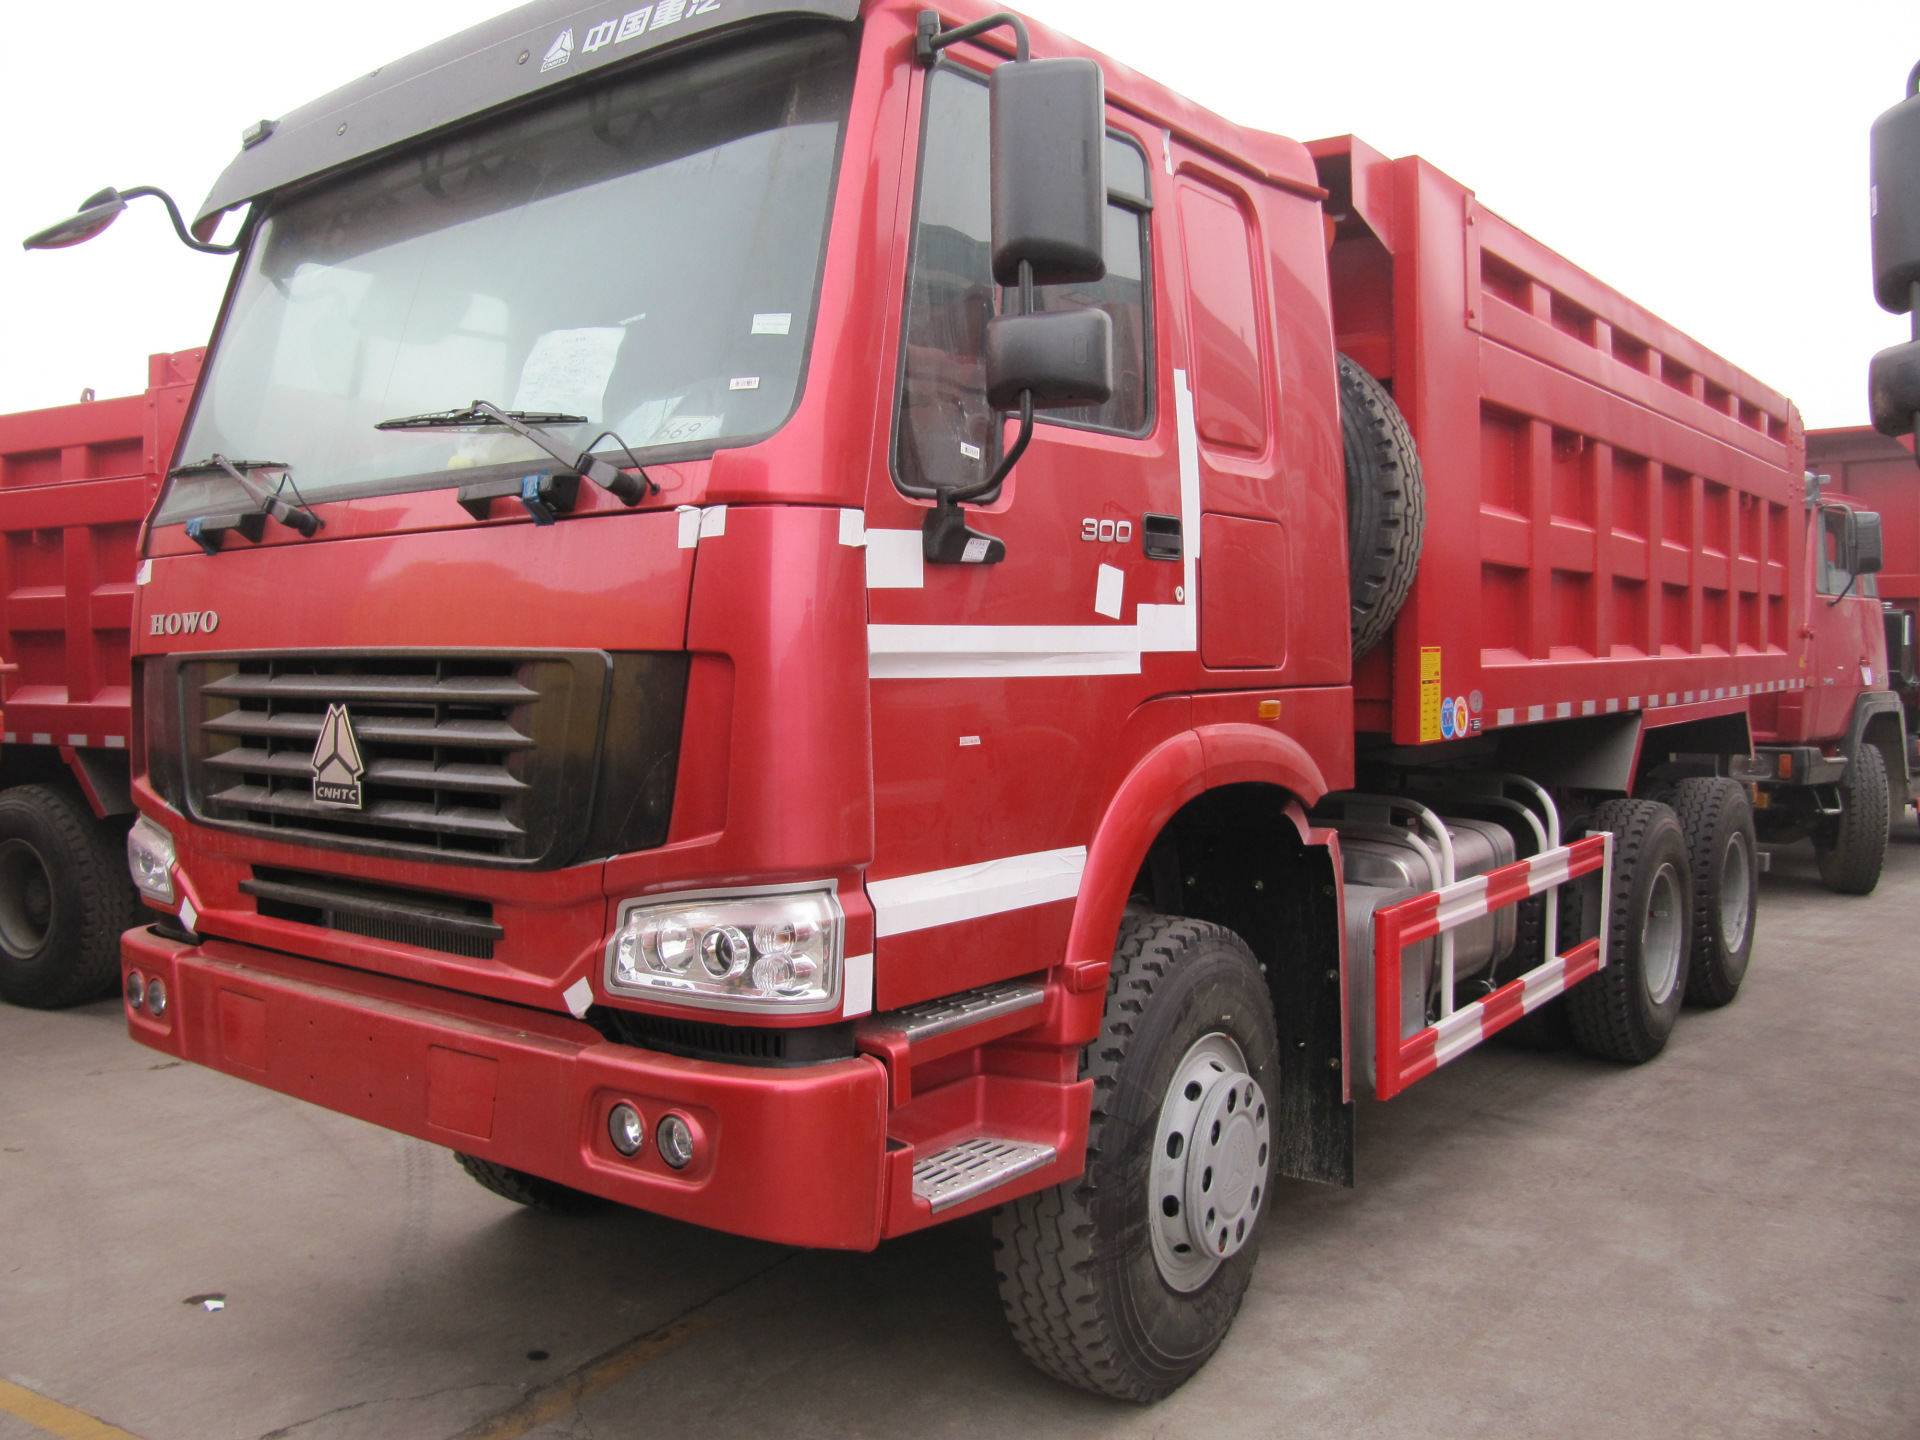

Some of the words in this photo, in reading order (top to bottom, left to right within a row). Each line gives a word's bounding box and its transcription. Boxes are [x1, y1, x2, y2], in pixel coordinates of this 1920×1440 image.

[1081, 517, 1132, 543] 300
[149, 610, 219, 635] HOWO
[316, 786, 357, 800] CNHTC
